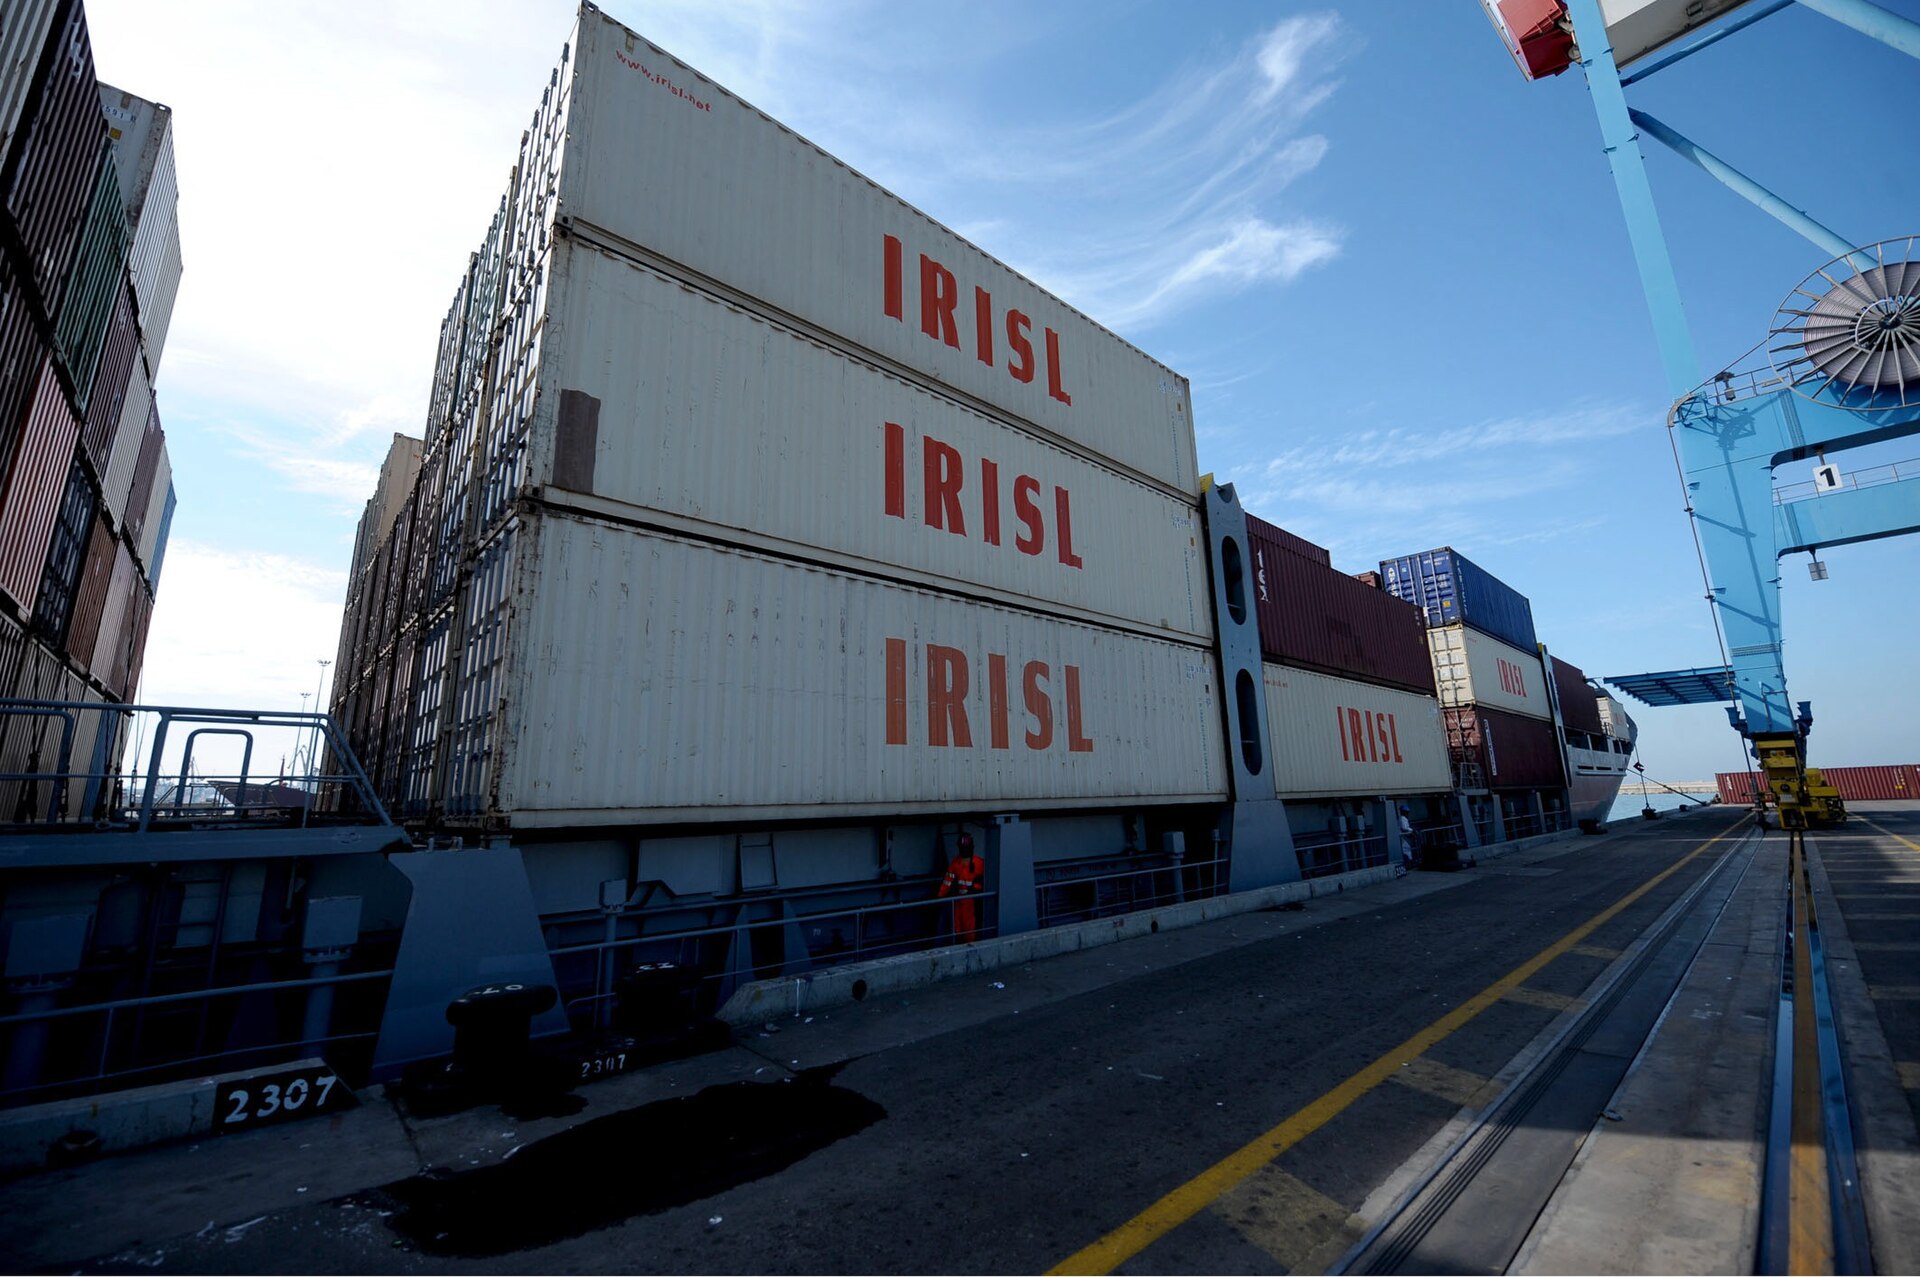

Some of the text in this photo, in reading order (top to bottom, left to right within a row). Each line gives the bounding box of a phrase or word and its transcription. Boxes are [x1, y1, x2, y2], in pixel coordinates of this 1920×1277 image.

[883, 234, 1072, 406] IRISL
[884, 422, 1083, 569] IRISL
[1820, 468, 1836, 486] 1
[886, 638, 1094, 752] IRISL
[1496, 657, 1528, 698] IRISL
[1336, 705, 1404, 763] IRISL
[224, 1075, 338, 1123] 2307
